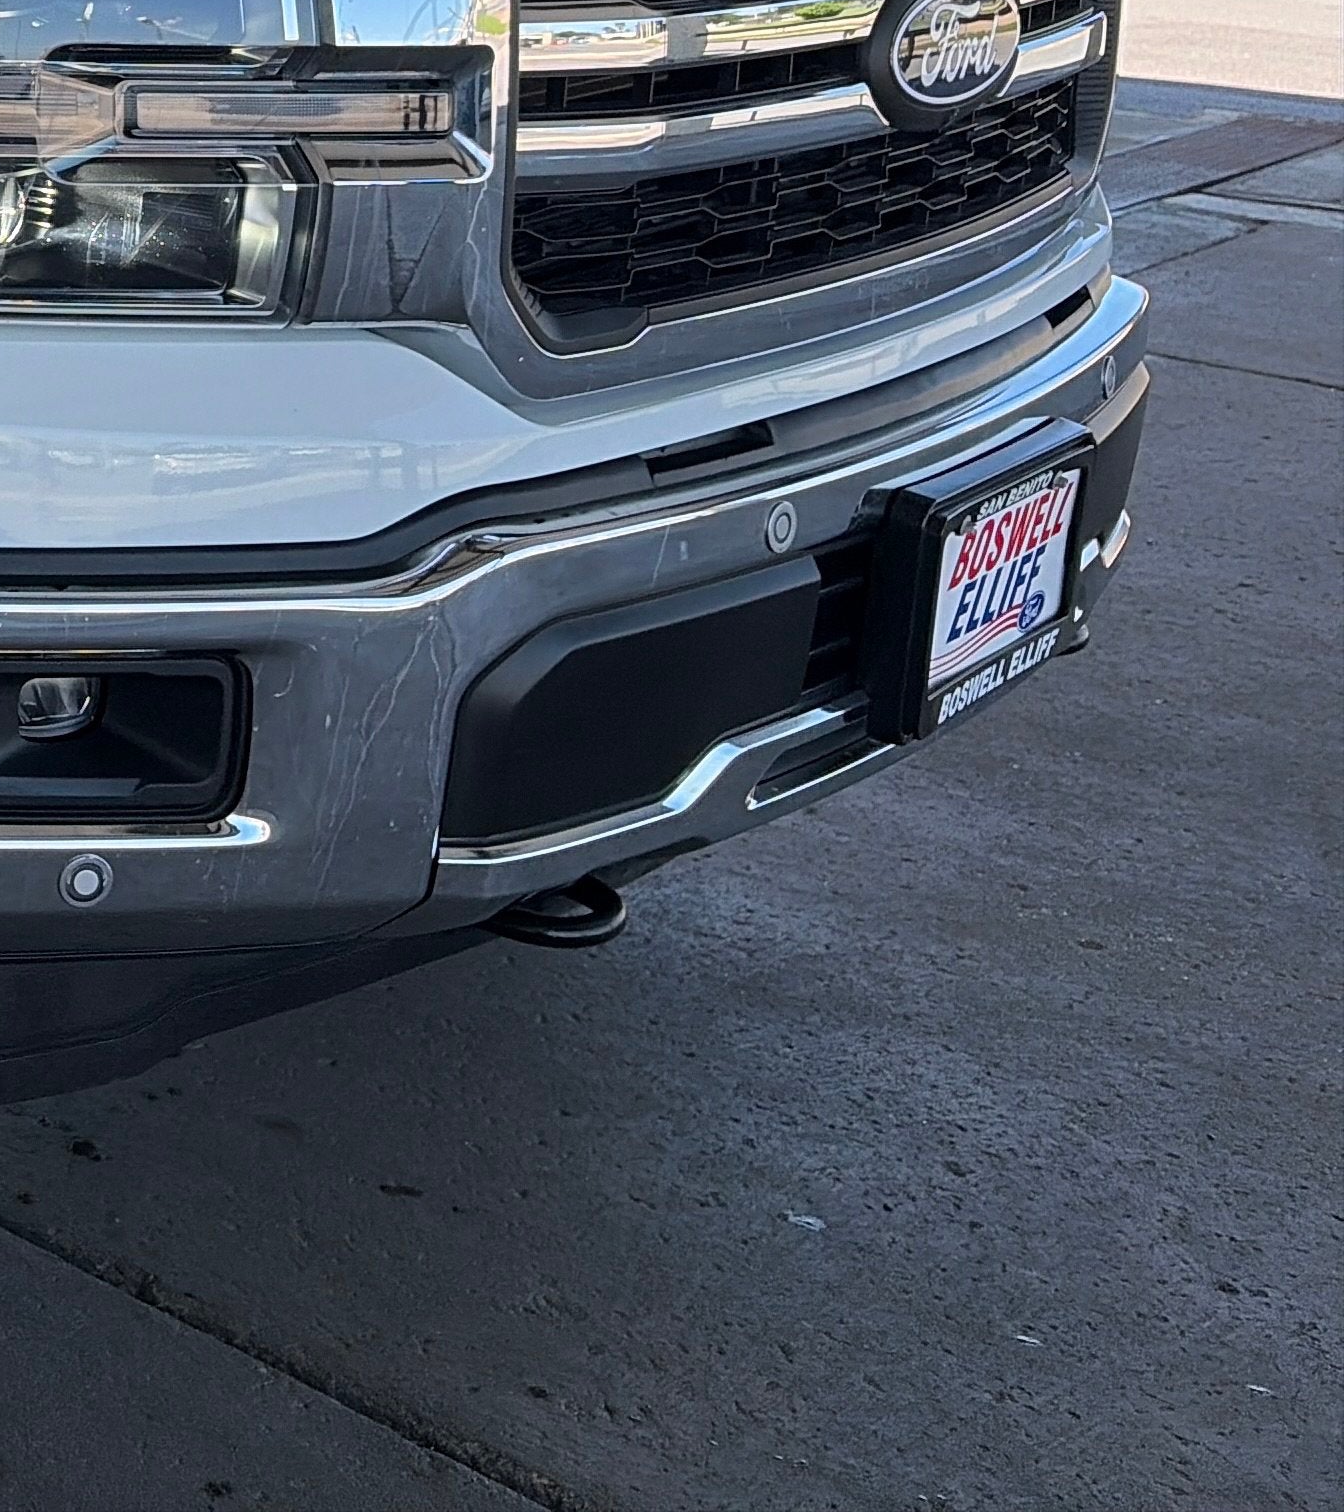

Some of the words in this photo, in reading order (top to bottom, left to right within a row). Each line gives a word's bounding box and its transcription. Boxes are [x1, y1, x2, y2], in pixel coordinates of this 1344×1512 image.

[920, 0, 998, 88] Ford
[946, 481, 1075, 592] BOSWELL
[977, 493, 1009, 520] SAN
[1007, 470, 1055, 510] BENITO
[945, 544, 1049, 644] ELLIFF
[937, 657, 1005, 726] BOSWELL
[1004, 627, 1062, 683] ELLIFF
